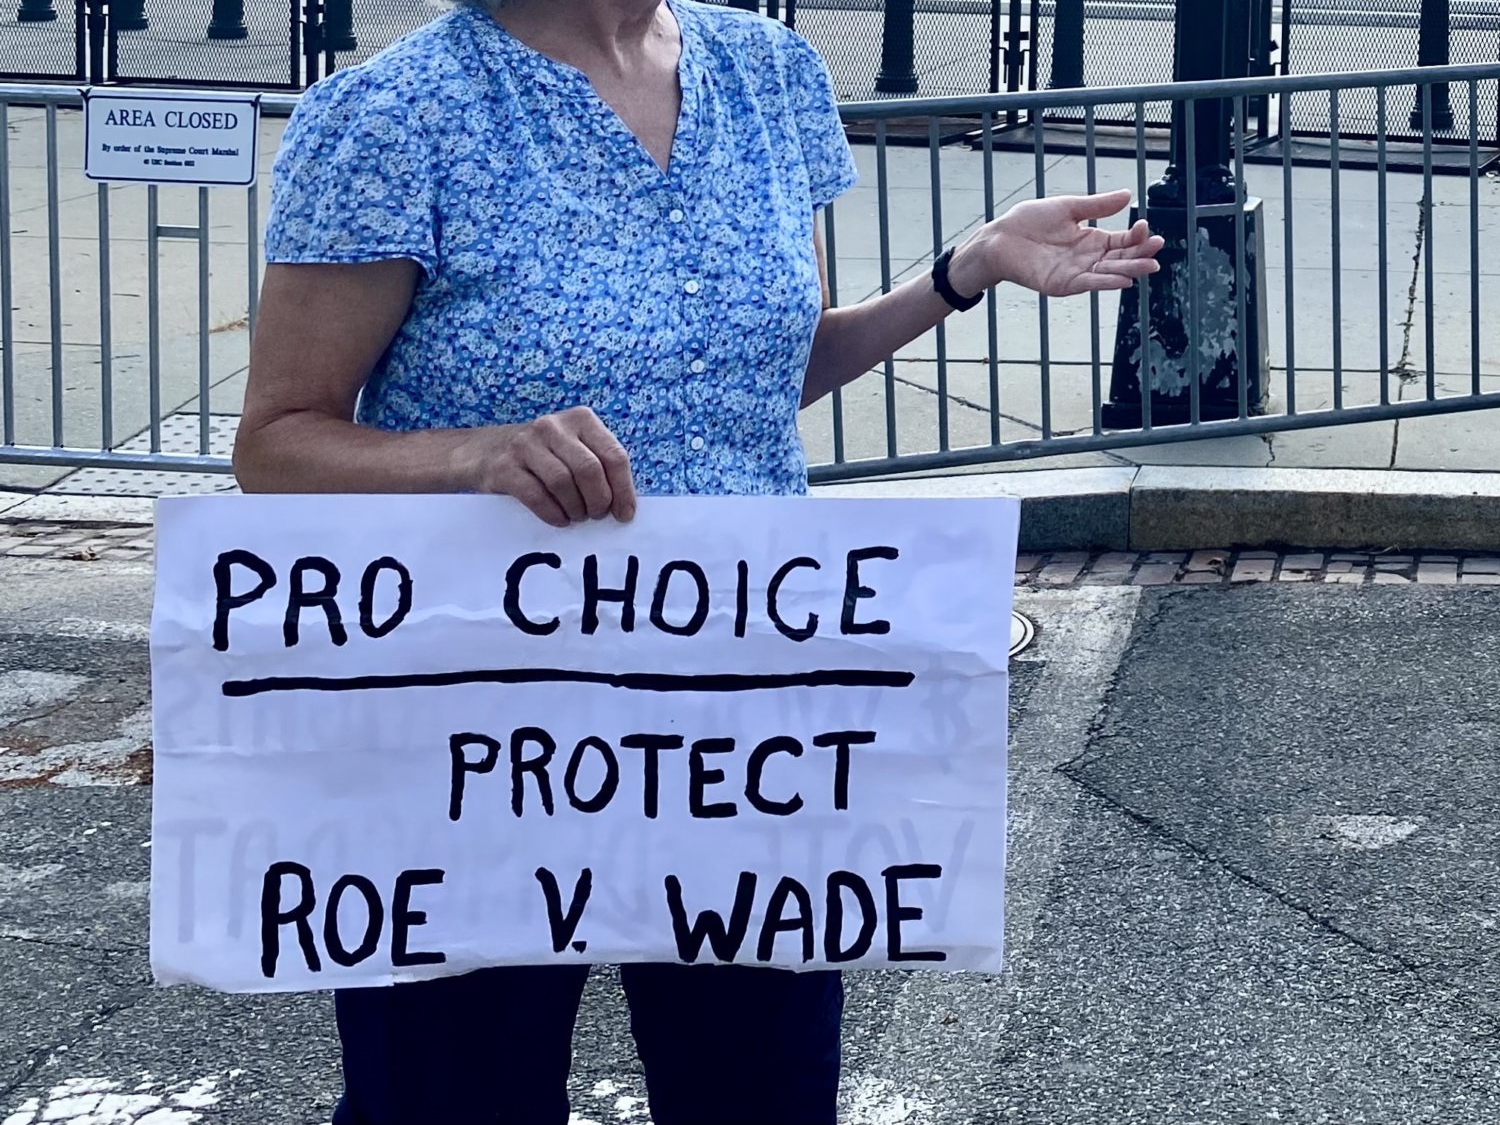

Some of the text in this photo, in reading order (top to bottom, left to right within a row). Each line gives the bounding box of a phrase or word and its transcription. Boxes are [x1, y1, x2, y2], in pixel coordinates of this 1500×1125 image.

[105, 109, 238, 130] AREA CLOSED
[134, 144, 142, 152] of
[188, 146, 209, 155] Court
[213, 546, 900, 651] PRO CHOICE
[449, 727, 876, 821] PROTECT
[260, 861, 446, 979] ROE
[535, 866, 592, 953] V.
[664, 863, 947, 963] WADE
